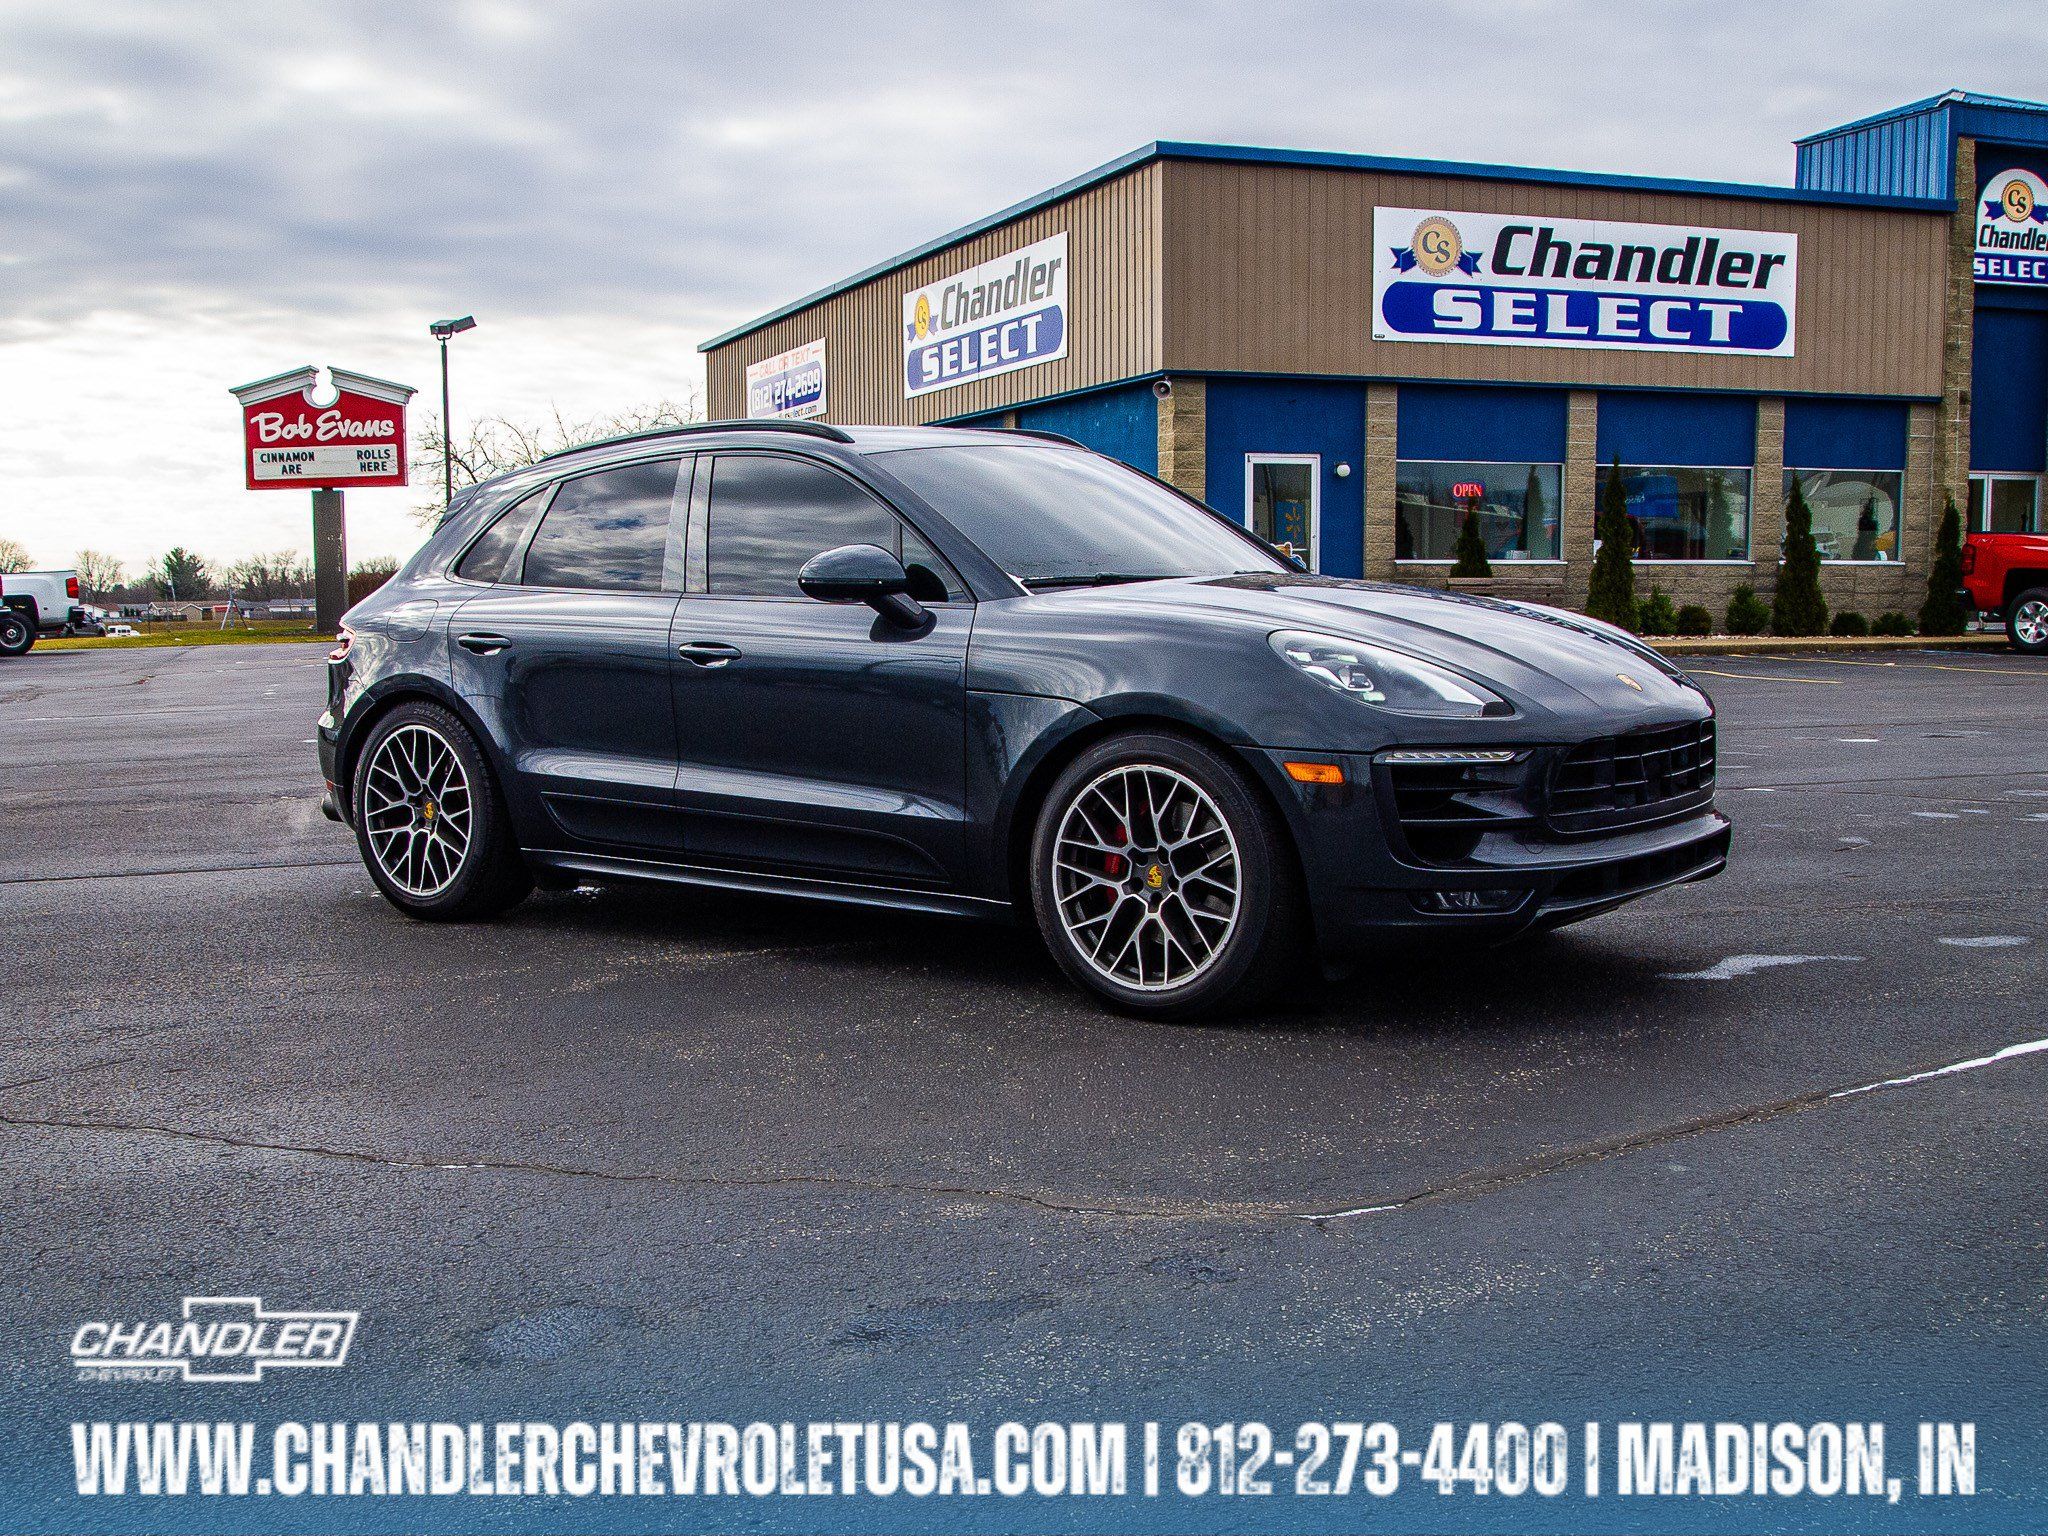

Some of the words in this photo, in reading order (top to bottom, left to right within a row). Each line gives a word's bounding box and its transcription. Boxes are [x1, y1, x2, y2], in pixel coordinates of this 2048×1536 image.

[1421, 230, 1451, 264] CS
[1978, 224, 2048, 252] Chandle
[1490, 224, 1787, 290] Chandler
[1974, 257, 2048, 279] SELEC
[940, 256, 1062, 331] Chandler
[1432, 288, 1744, 342] SELECT
[921, 313, 1043, 383] SELECT
[250, 411, 314, 443] Bob
[315, 409, 395, 442] Evans
[260, 450, 315, 464] CINNAMON
[356, 449, 391, 461] ROLLS
[281, 464, 303, 475] ARE
[359, 461, 388, 473] HERE
[1453, 483, 1483, 498] OPEN
